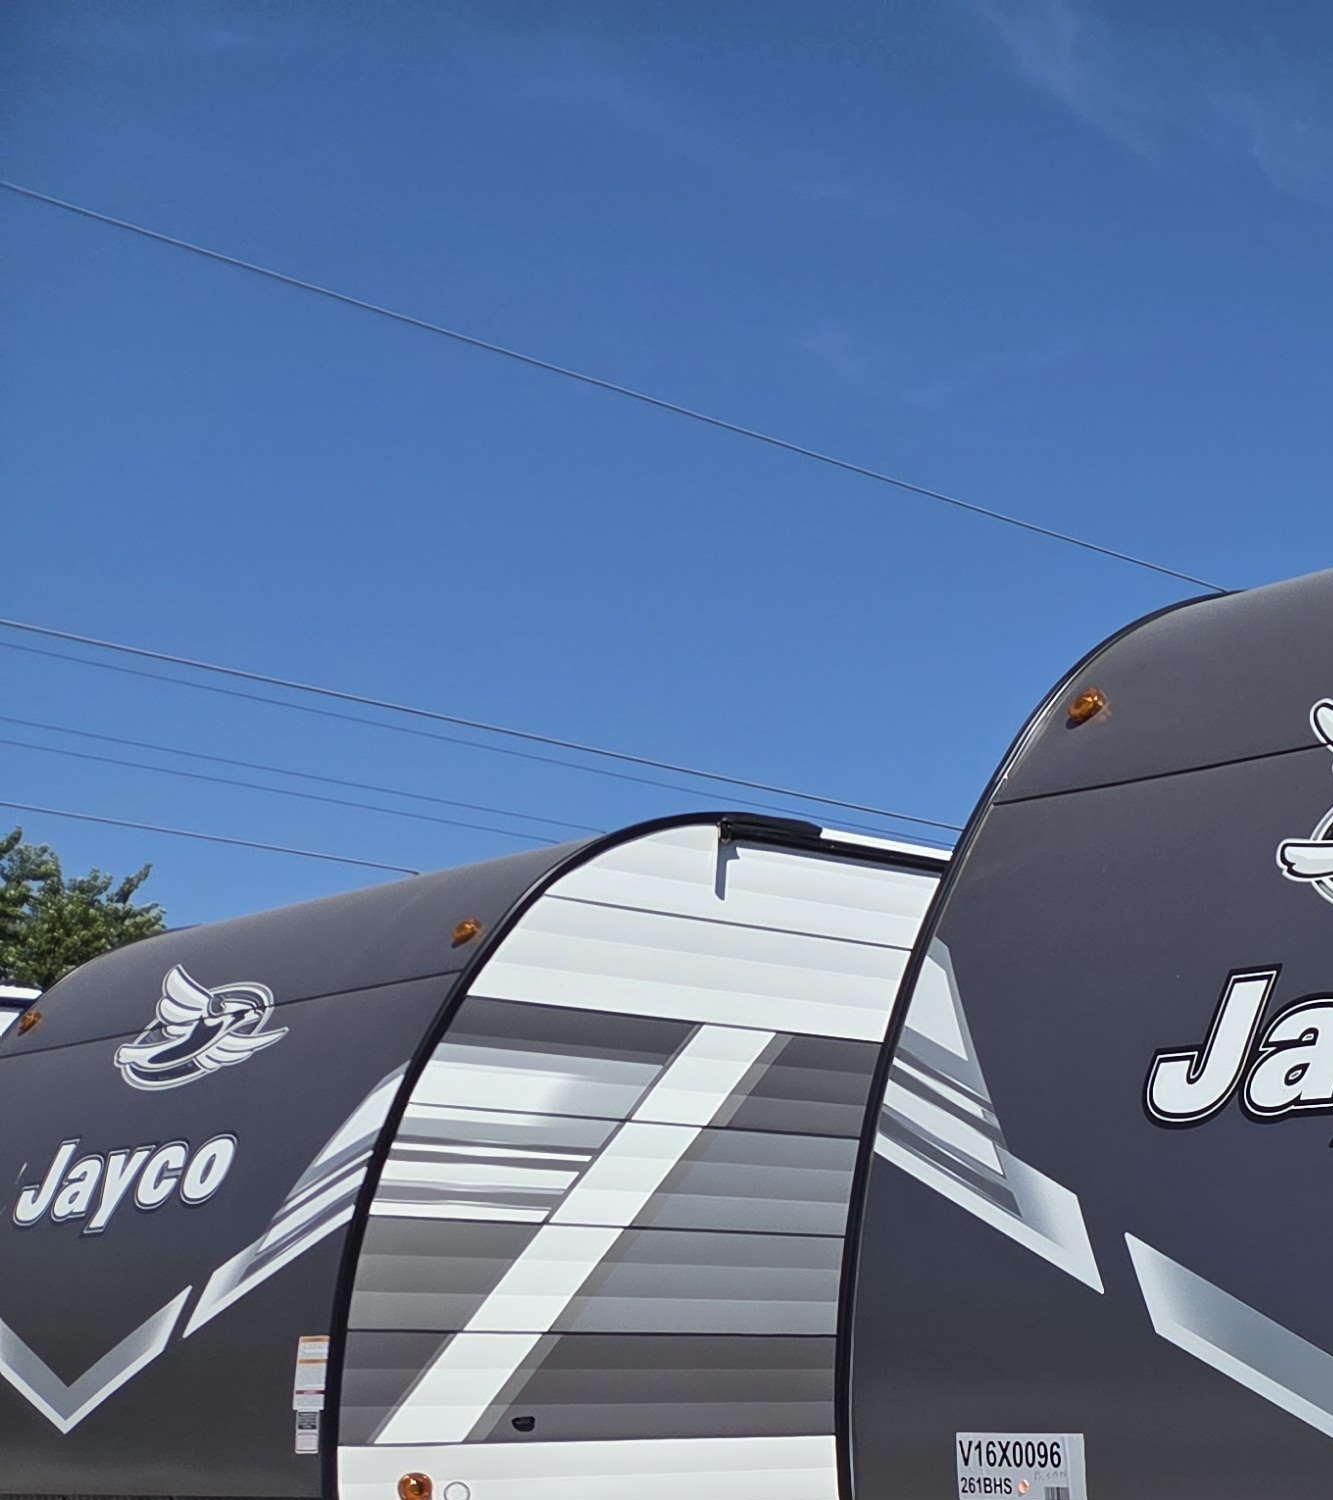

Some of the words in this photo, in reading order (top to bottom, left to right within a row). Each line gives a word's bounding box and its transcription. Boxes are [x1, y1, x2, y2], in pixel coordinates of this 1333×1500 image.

[12, 1132, 238, 1235] Jayco
[958, 1440, 1062, 1468] V16X0096
[960, 1477, 1012, 1494] 261BHS
